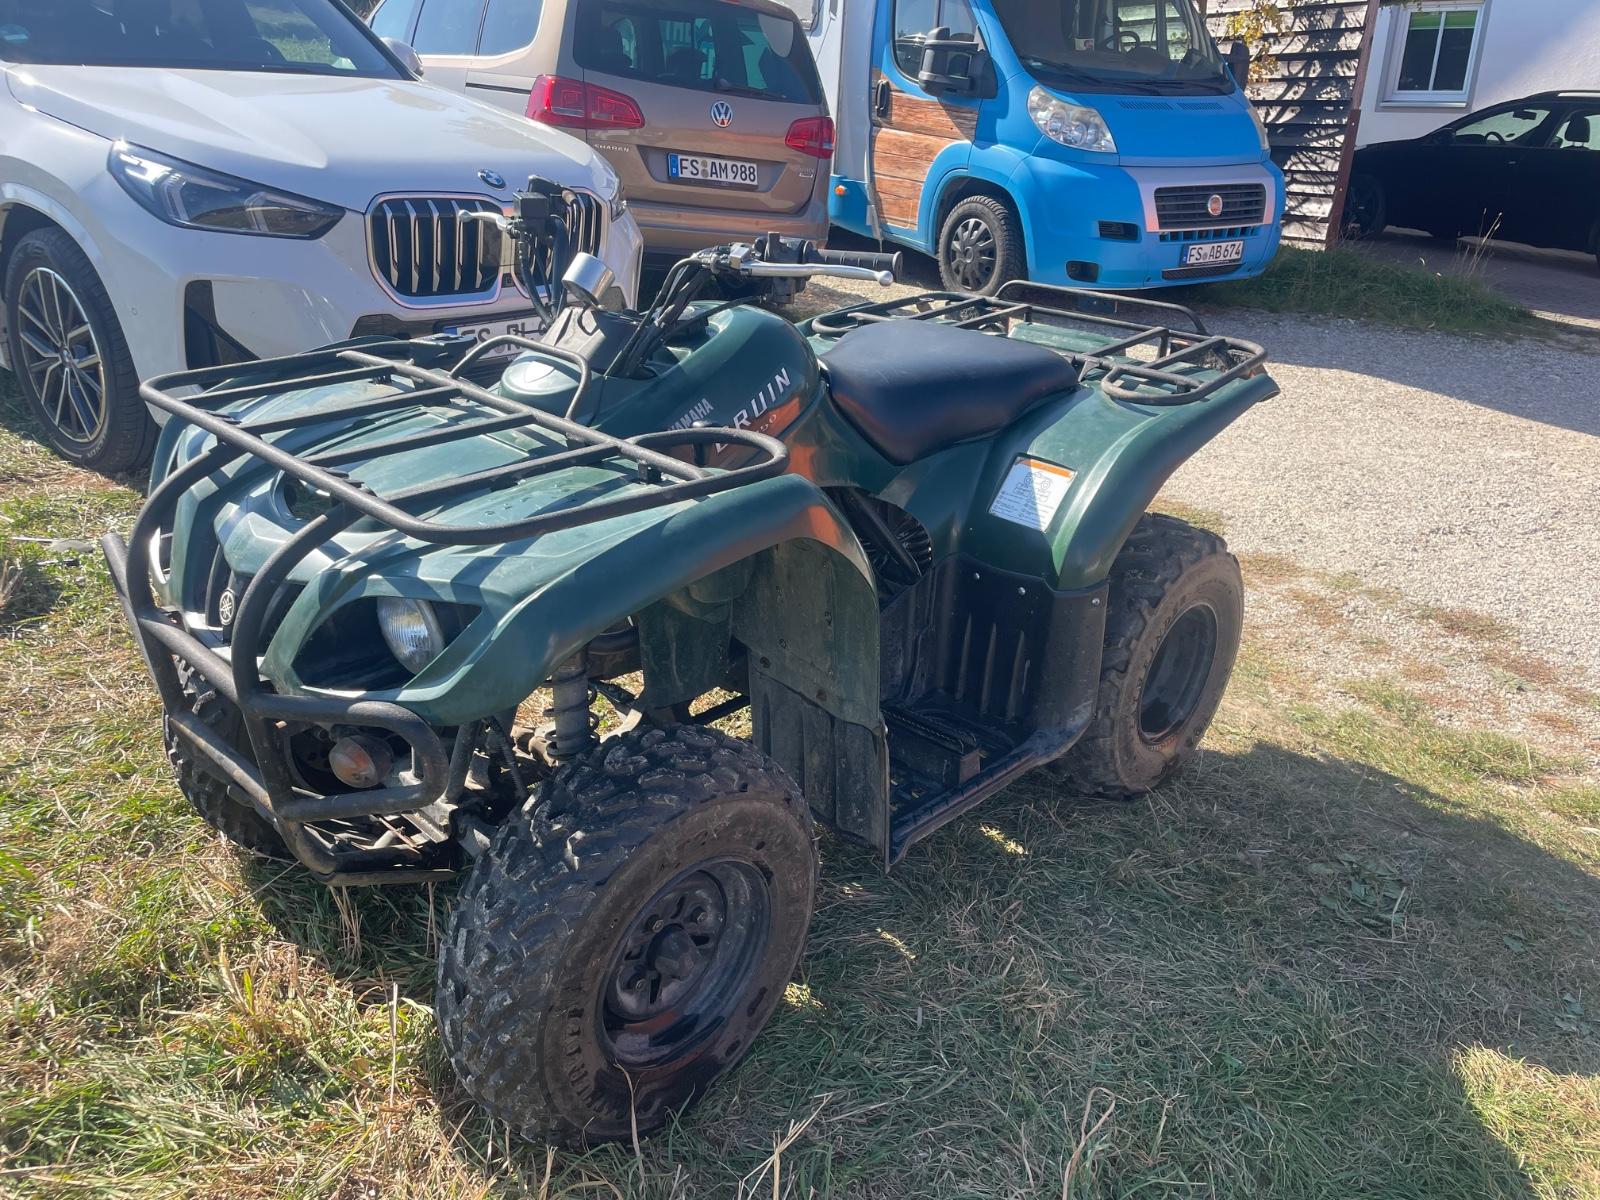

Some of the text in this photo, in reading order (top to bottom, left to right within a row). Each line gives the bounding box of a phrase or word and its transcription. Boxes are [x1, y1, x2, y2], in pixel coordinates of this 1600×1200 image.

[680, 158, 756, 182] FS AM 988
[1189, 243, 1241, 262] FS AB 674
